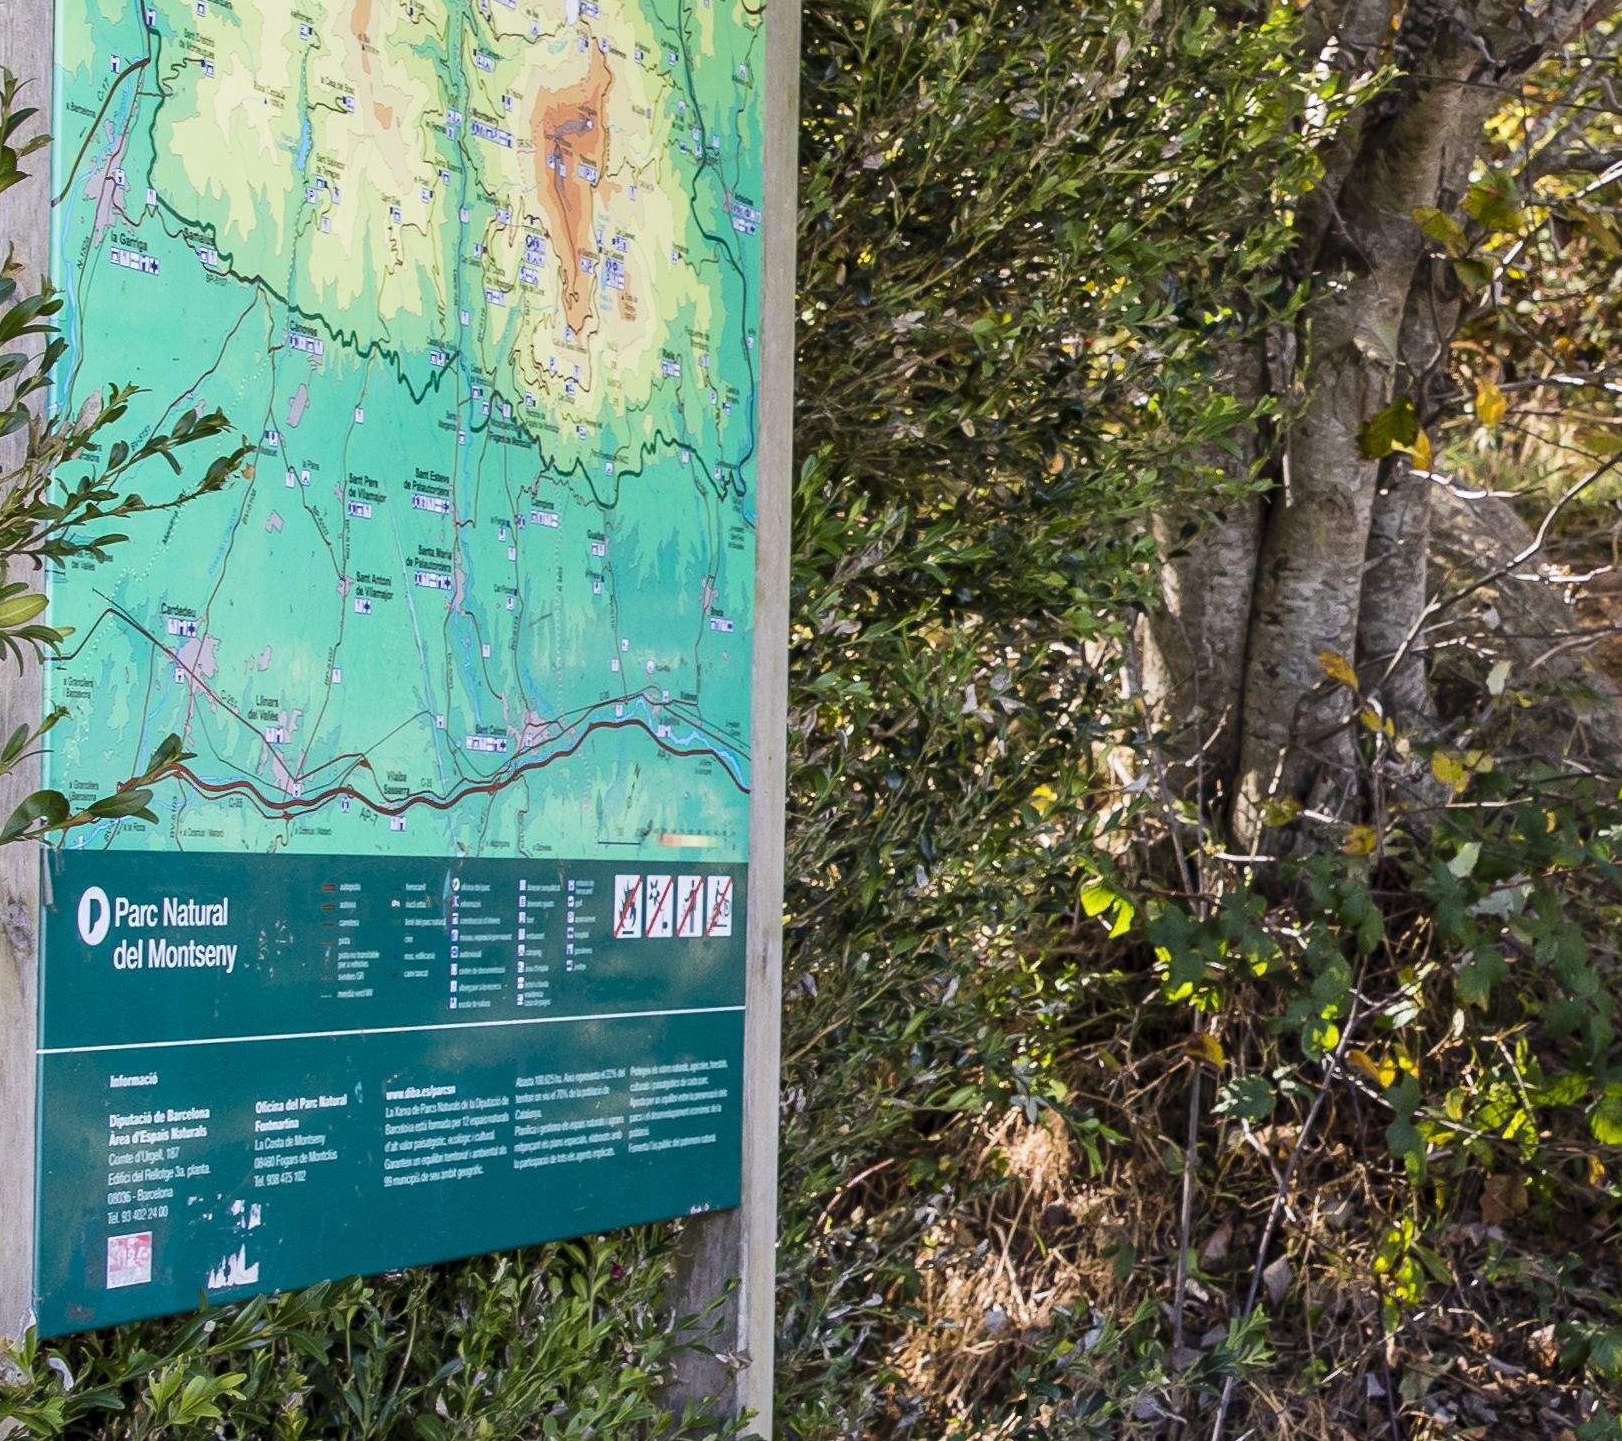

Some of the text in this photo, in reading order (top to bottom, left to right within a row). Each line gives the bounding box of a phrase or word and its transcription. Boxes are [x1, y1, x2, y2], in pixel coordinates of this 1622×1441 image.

[119, 233, 148, 252] Garriga
[349, 473, 378, 488] Sant Pere
[415, 467, 450, 484] Sant Esteve
[403, 480, 411, 490] de
[348, 487, 387, 505] de Vilamajor
[419, 544, 452, 560] Santa Maria
[406, 557, 414, 567] de
[356, 571, 391, 586] Sant Antoni
[356, 586, 394, 602] de Vilamajor
[162, 602, 196, 618] Cardedeu
[256, 695, 279, 708] Llinars
[248, 710, 259, 721] del
[476, 724, 488, 734] Sant
[387, 771, 407, 782] Vilalba
[115, 897, 228, 928] Parc Natural
[113, 938, 237, 973] del Montseny
[110, 1072, 158, 1088] Informació
[255, 1093, 348, 1114] Oficina del Parc Natural
[385, 1107, 394, 1118] La
[411, 1106, 420, 1115] de
[420, 1103, 437, 1114] Parcs
[109, 1107, 210, 1129] Diputació de Barcelona
[255, 1118, 299, 1132] Fontmartina
[109, 1125, 207, 1147] Àrea d'Espais Naturals
[255, 1133, 326, 1151] La Costa de Montseny
[108, 1151, 133, 1166] Comte
[276, 1153, 298, 1168] Fogars
[300, 1152, 308, 1165] de
[309, 1149, 338, 1162] Montclús
[108, 1170, 130, 1186] Edifici
[132, 1169, 143, 1183] del
[254, 1175, 265, 1187] Tel.
[137, 1186, 174, 1201] Barcelona
[107, 1211, 120, 1225] Tel.
[121, 1210, 132, 1223] 93
